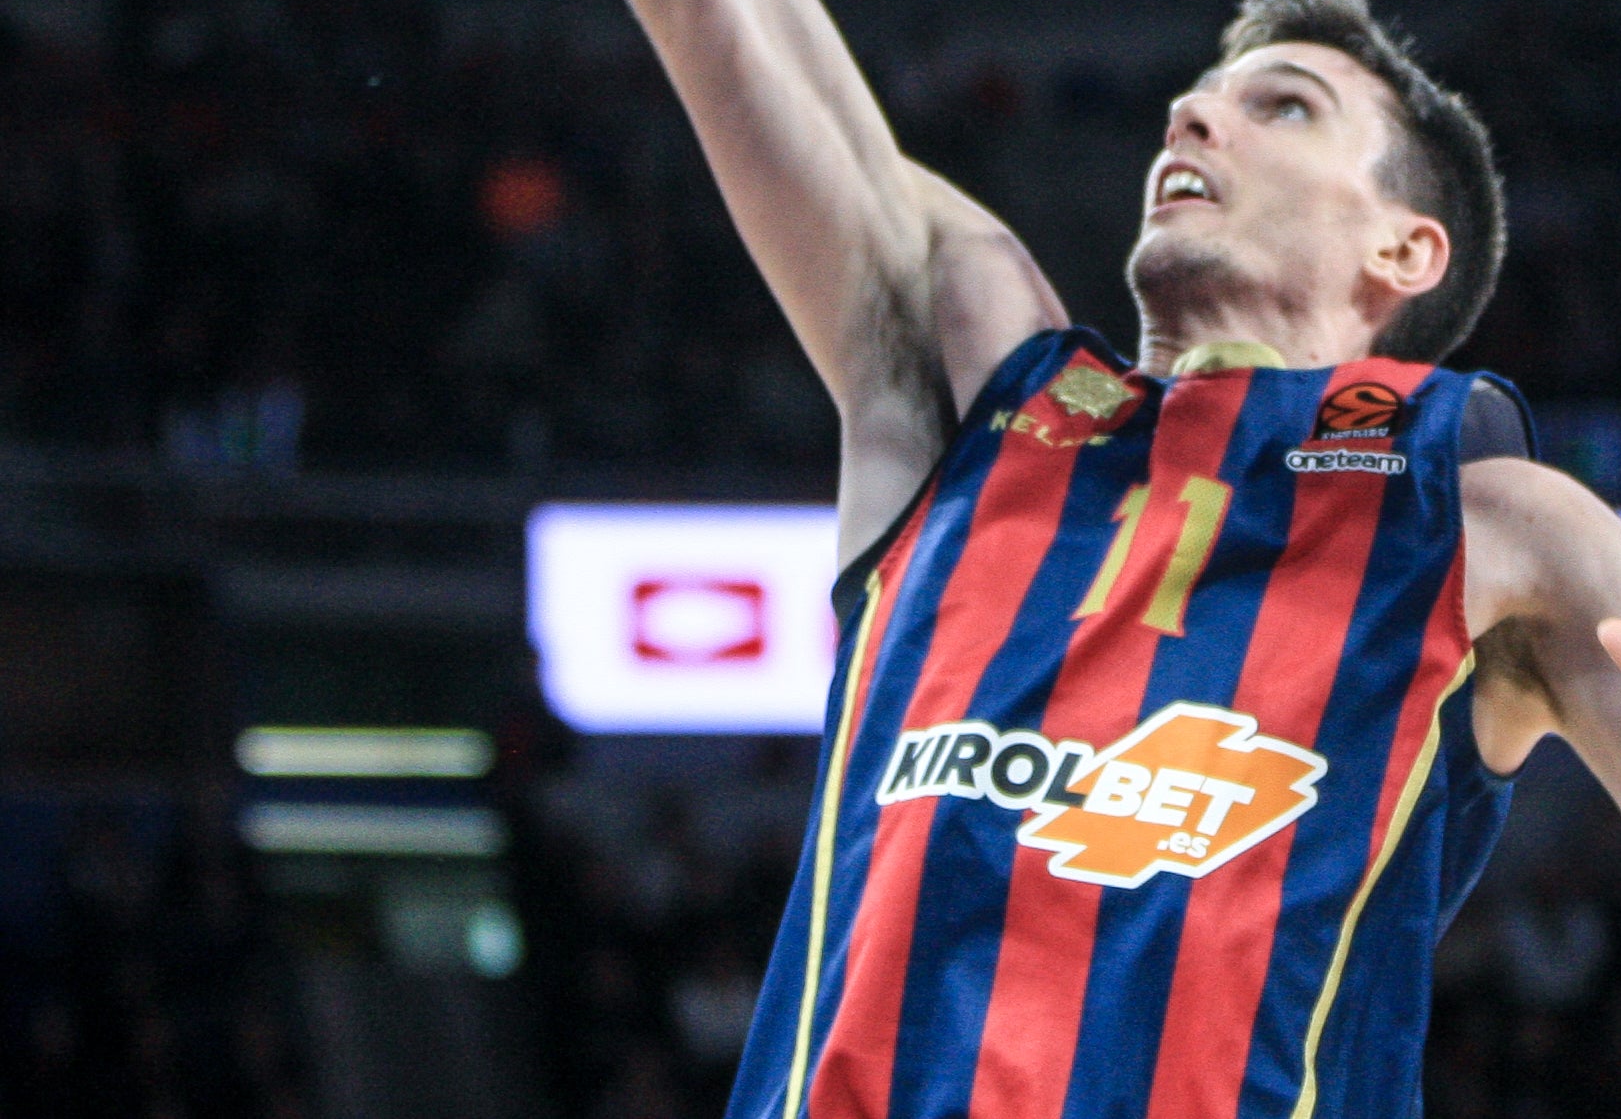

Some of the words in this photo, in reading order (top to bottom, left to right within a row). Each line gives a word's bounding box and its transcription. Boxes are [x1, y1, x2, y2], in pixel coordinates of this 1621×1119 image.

[1287, 450, 1405, 473] oneteam
[1075, 475, 1232, 638] 11
[1157, 831, 1211, 859] .es
